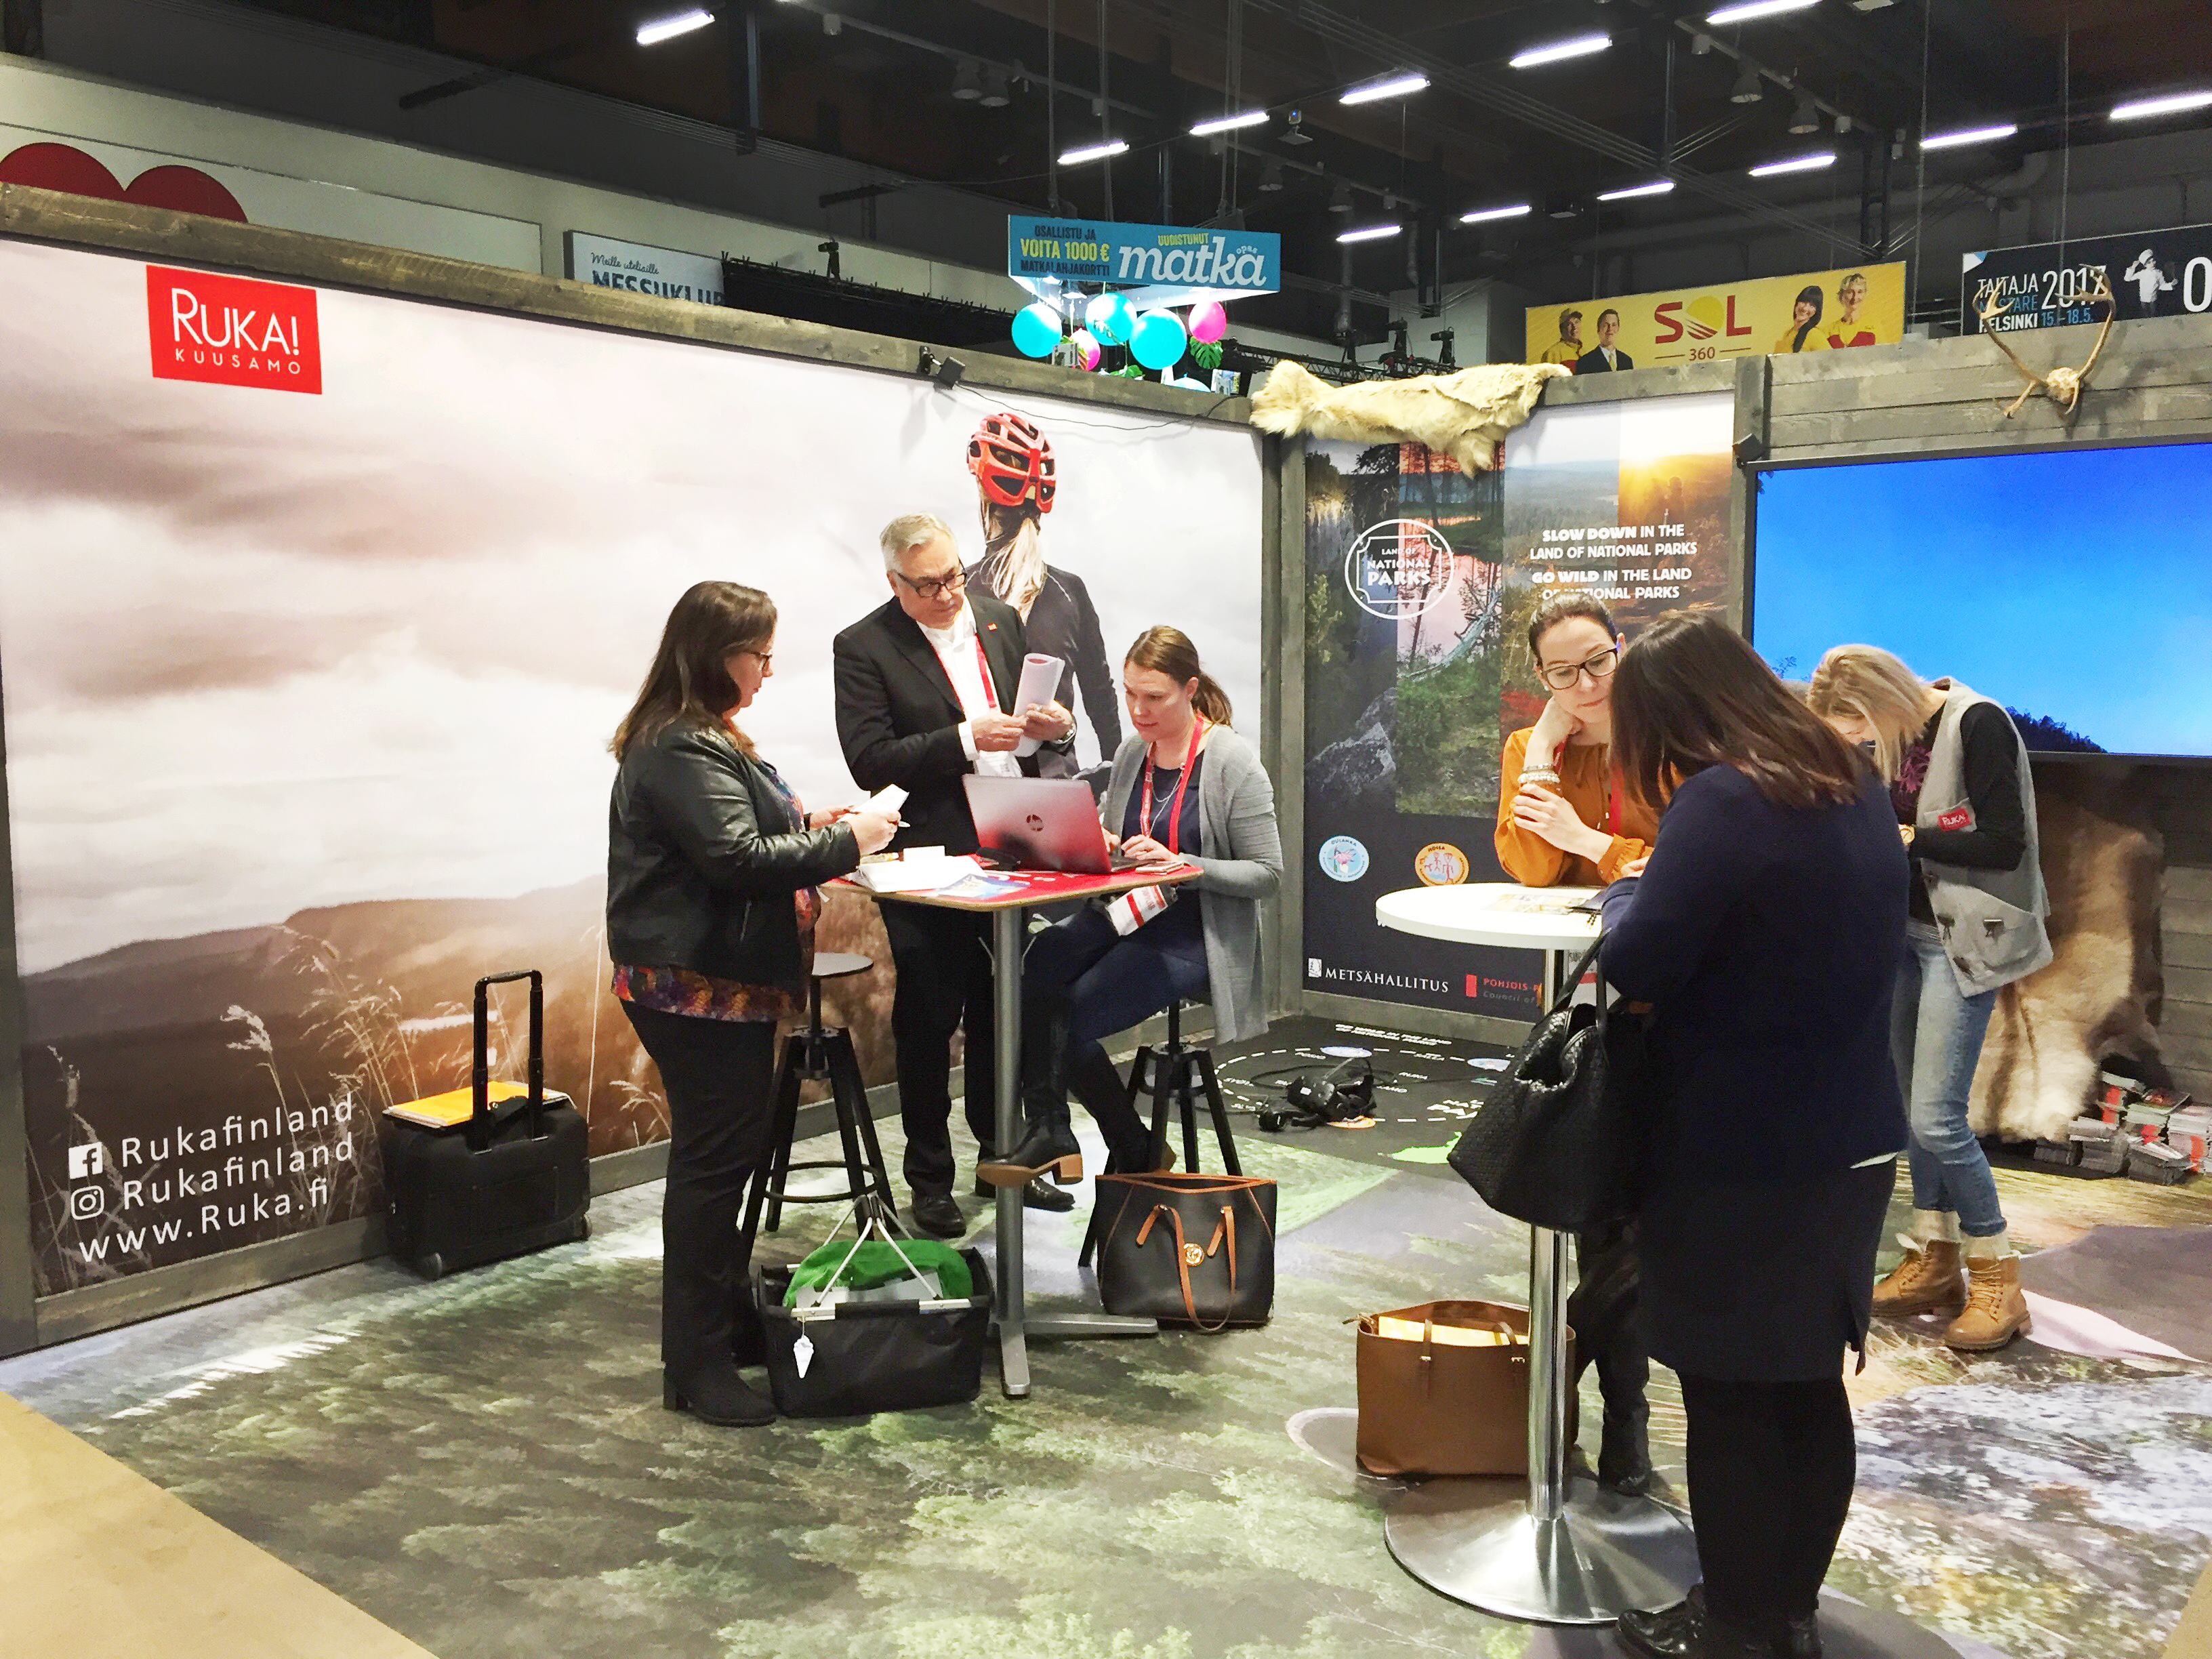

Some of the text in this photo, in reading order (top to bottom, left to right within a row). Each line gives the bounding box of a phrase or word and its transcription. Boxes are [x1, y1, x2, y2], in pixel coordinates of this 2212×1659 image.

[1035, 225, 1096, 240] OSALLISTU JA
[1158, 232, 1209, 246] UUDISTUNUT
[1020, 239, 1110, 262] VOITA 1000 €
[1236, 245, 1258, 255] opas
[591, 252, 621, 268] Meille
[1021, 260, 1110, 276] MATKALAHJAKORTTI
[1118, 236, 1267, 287] matka
[171, 287, 300, 356] RUKA!
[1654, 295, 1752, 344] SOL
[175, 348, 301, 375] KUUSAMO
[1689, 346, 1715, 361] 360
[1542, 524, 1685, 542] SLOW DOWN IN THE
[1530, 541, 1698, 560] LAND OF NATIONAL PARKS
[1367, 558, 1431, 569] NATIONAL
[1368, 570, 1431, 586] PARKS
[1532, 567, 1692, 583] GO WILD IN THE LAND
[1635, 586, 1680, 599] PARKS
[1325, 967, 1449, 994] METSÄHALLITUS
[121, 1092, 352, 1168] Rukafinland
[123, 1132, 352, 1210] Rukafinland
[79, 1177, 327, 1263] www.Ruka.fi
